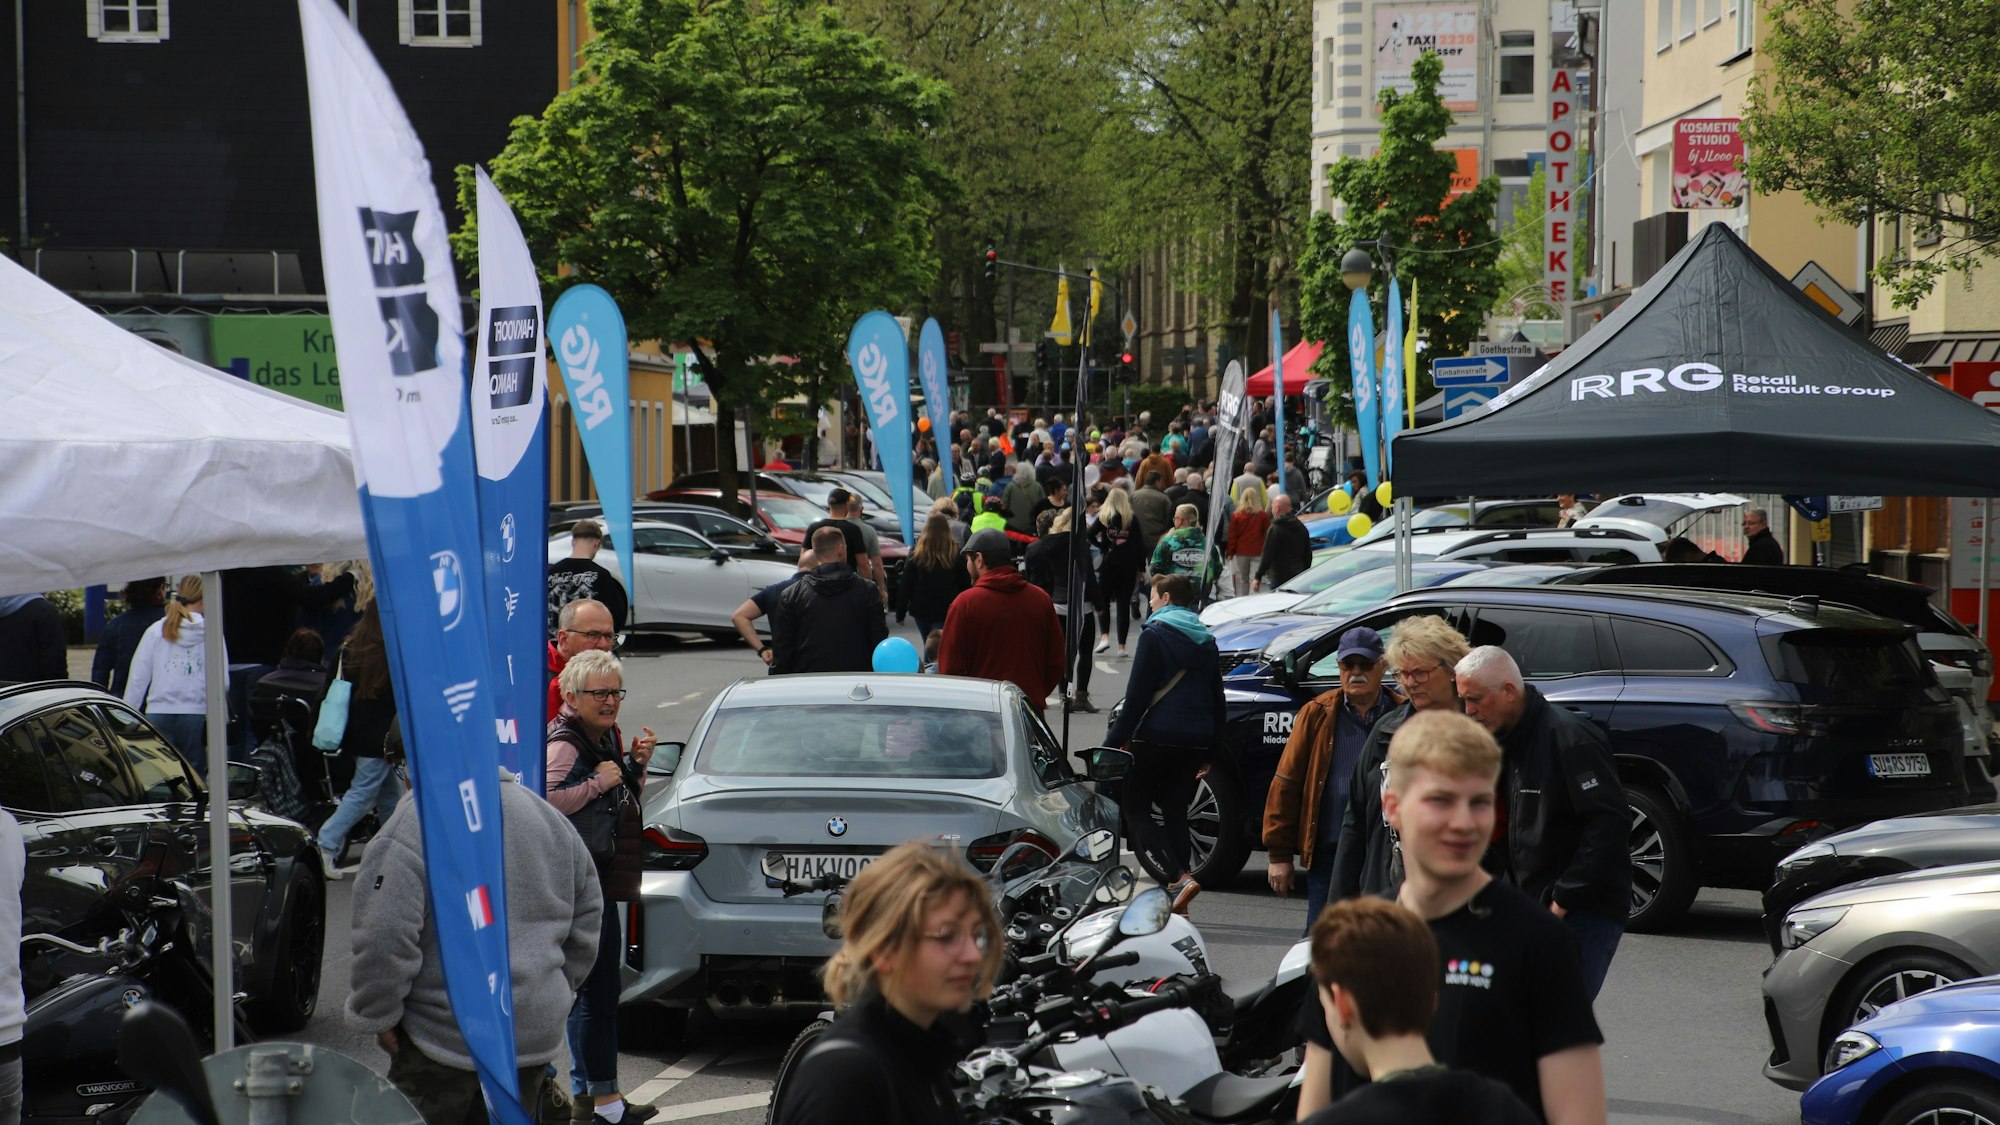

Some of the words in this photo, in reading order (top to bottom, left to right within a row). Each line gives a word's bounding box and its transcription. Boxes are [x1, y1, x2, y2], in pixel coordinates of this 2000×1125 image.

[1407, 36, 1436, 46] TAXI
[1439, 34, 1475, 45] 2220
[1680, 122, 1740, 133] KOSMETIK
[1688, 134, 1731, 145] STUDIO
[1549, 71, 1572, 301] APOTHEKE
[1480, 345, 1532, 354] Goethestraße
[255, 361, 301, 386] das
[1438, 367, 1487, 377] Einbahnstraße
[1571, 362, 1724, 401] RRG
[1732, 373, 1796, 386] Retail
[1732, 382, 1820, 395] Renault
[1823, 385, 1896, 398] Group
[1263, 712, 1298, 733] RR
[1873, 756, 1887, 772] SU
[1891, 756, 1906, 772] RS
[787, 857, 878, 879] HAKVOO
[87, 1082, 136, 1093] HAKVOORT
